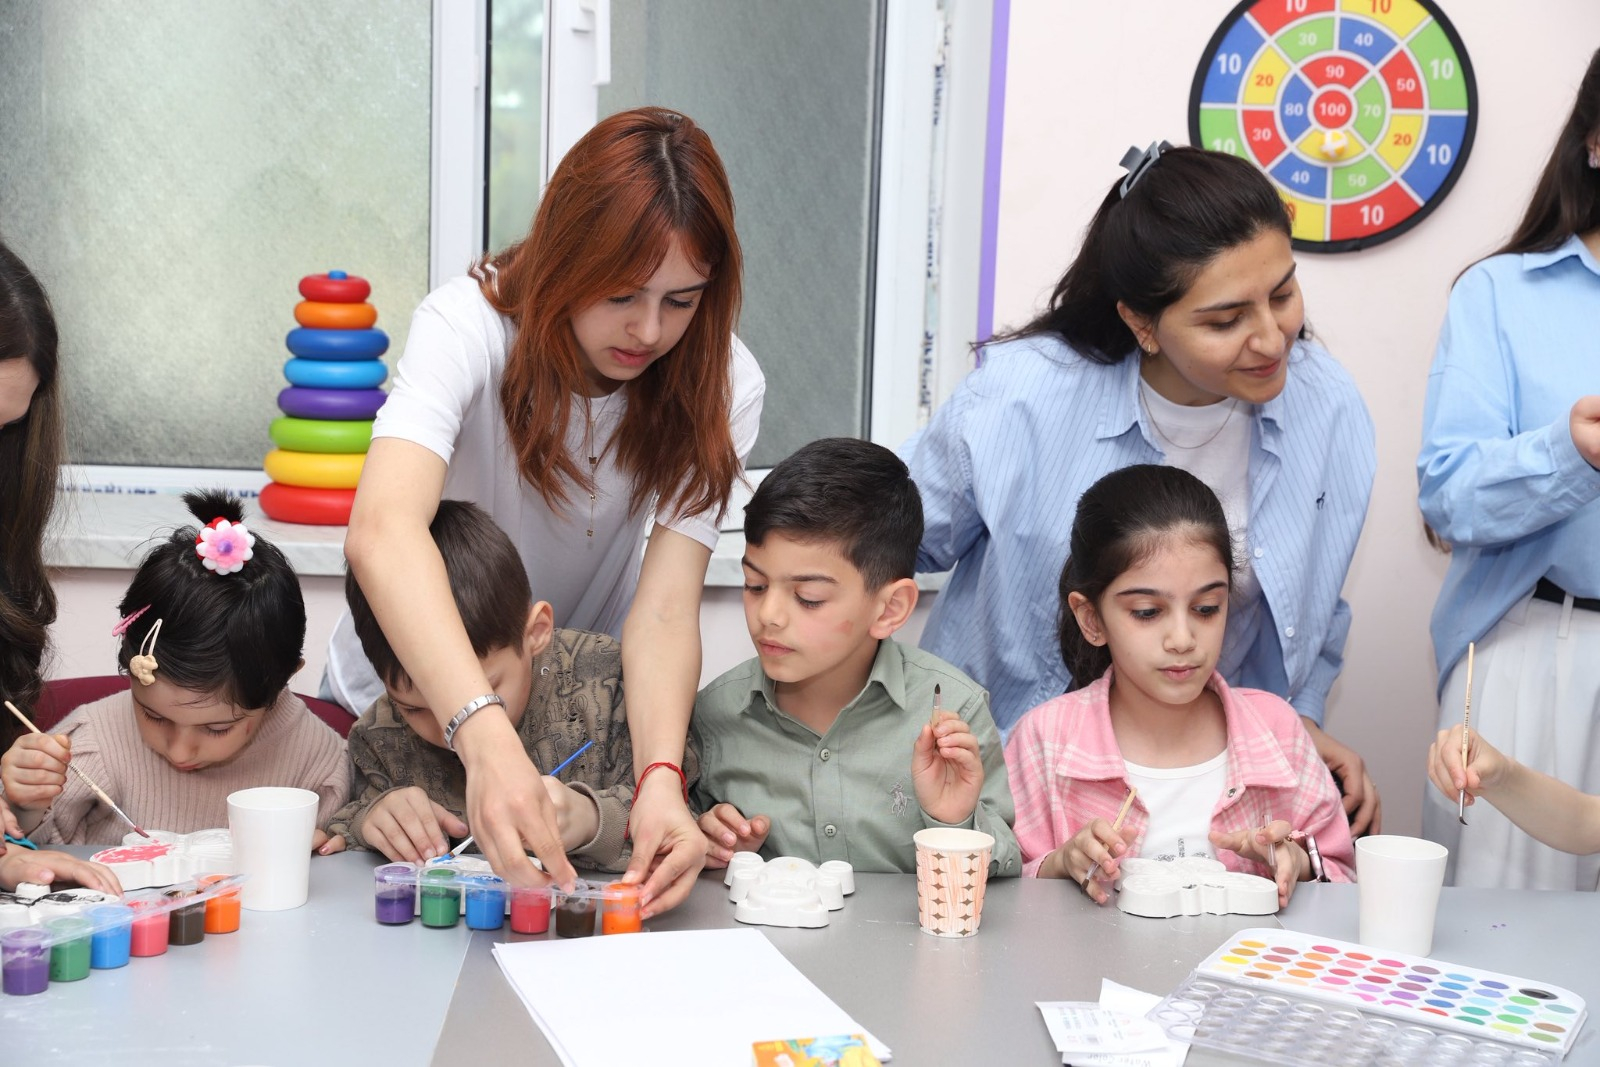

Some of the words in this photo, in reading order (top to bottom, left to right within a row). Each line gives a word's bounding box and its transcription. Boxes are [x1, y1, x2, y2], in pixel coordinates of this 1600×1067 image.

[1286, 0, 1307, 12] 10
[1371, 0, 1391, 14] 10
[1298, 33, 1317, 46] 30
[1354, 33, 1374, 47] 40
[1217, 53, 1241, 75] 10
[1430, 59, 1454, 80] 10
[1325, 65, 1345, 79] 90
[1255, 74, 1274, 87] 20
[1396, 78, 1415, 92] 50
[1285, 104, 1304, 117] 80
[1319, 103, 1346, 117] 100
[1363, 105, 1381, 118] 70
[1252, 128, 1272, 141] 30
[1393, 134, 1412, 146] 20
[1212, 138, 1236, 155] 10
[1426, 144, 1451, 165] 10
[1291, 170, 1310, 184] 40
[1360, 204, 1384, 225] 10
[1087, 1052, 1115, 1064] Color
